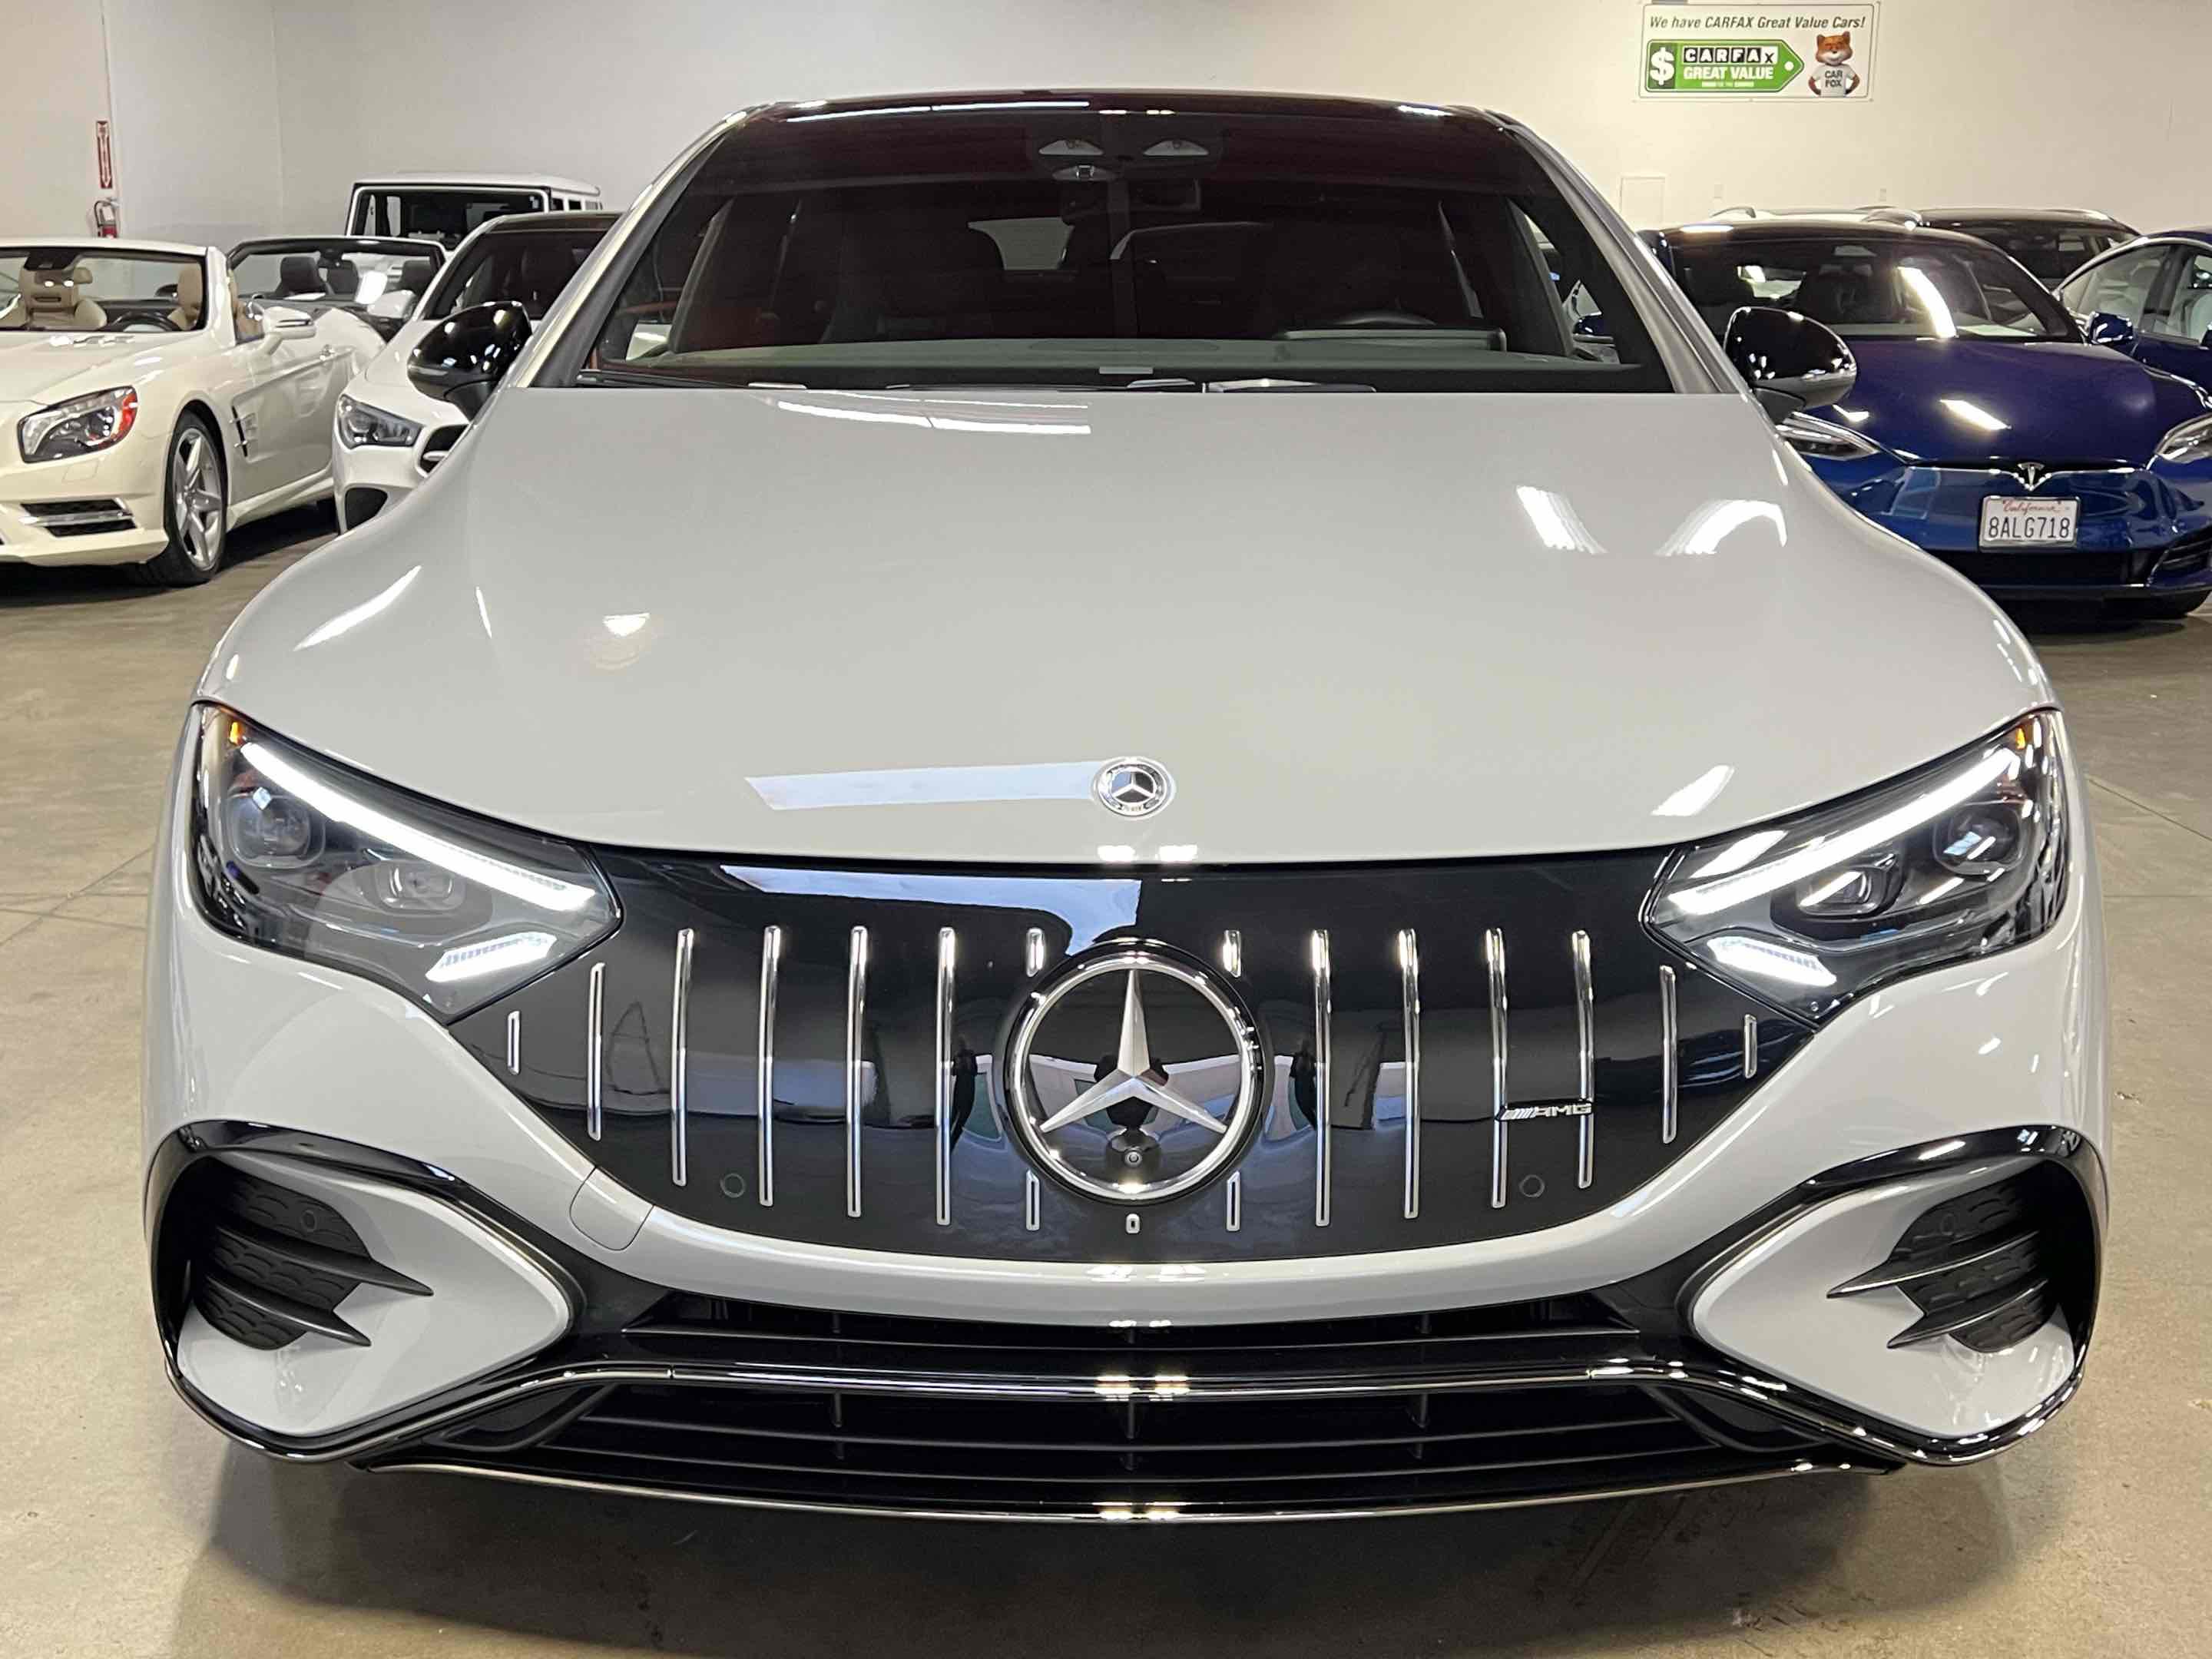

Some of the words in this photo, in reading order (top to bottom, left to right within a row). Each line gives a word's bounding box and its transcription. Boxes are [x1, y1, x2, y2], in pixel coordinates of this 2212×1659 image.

[1650, 15, 1668, 28] We
[1671, 15, 1701, 28] have
[1704, 16, 1754, 28] CARFAX
[1757, 16, 1791, 28] Great
[1795, 16, 1829, 28] Value
[1833, 16, 1866, 28] Cars!
[1683, 66, 1727, 80] GREAT
[1730, 66, 1774, 80] VALUE
[1824, 70, 1843, 78] CAR
[1825, 79, 1842, 88] FOX
[2003, 500, 2060, 515] California
[1988, 516, 2071, 538] 8ALG718
